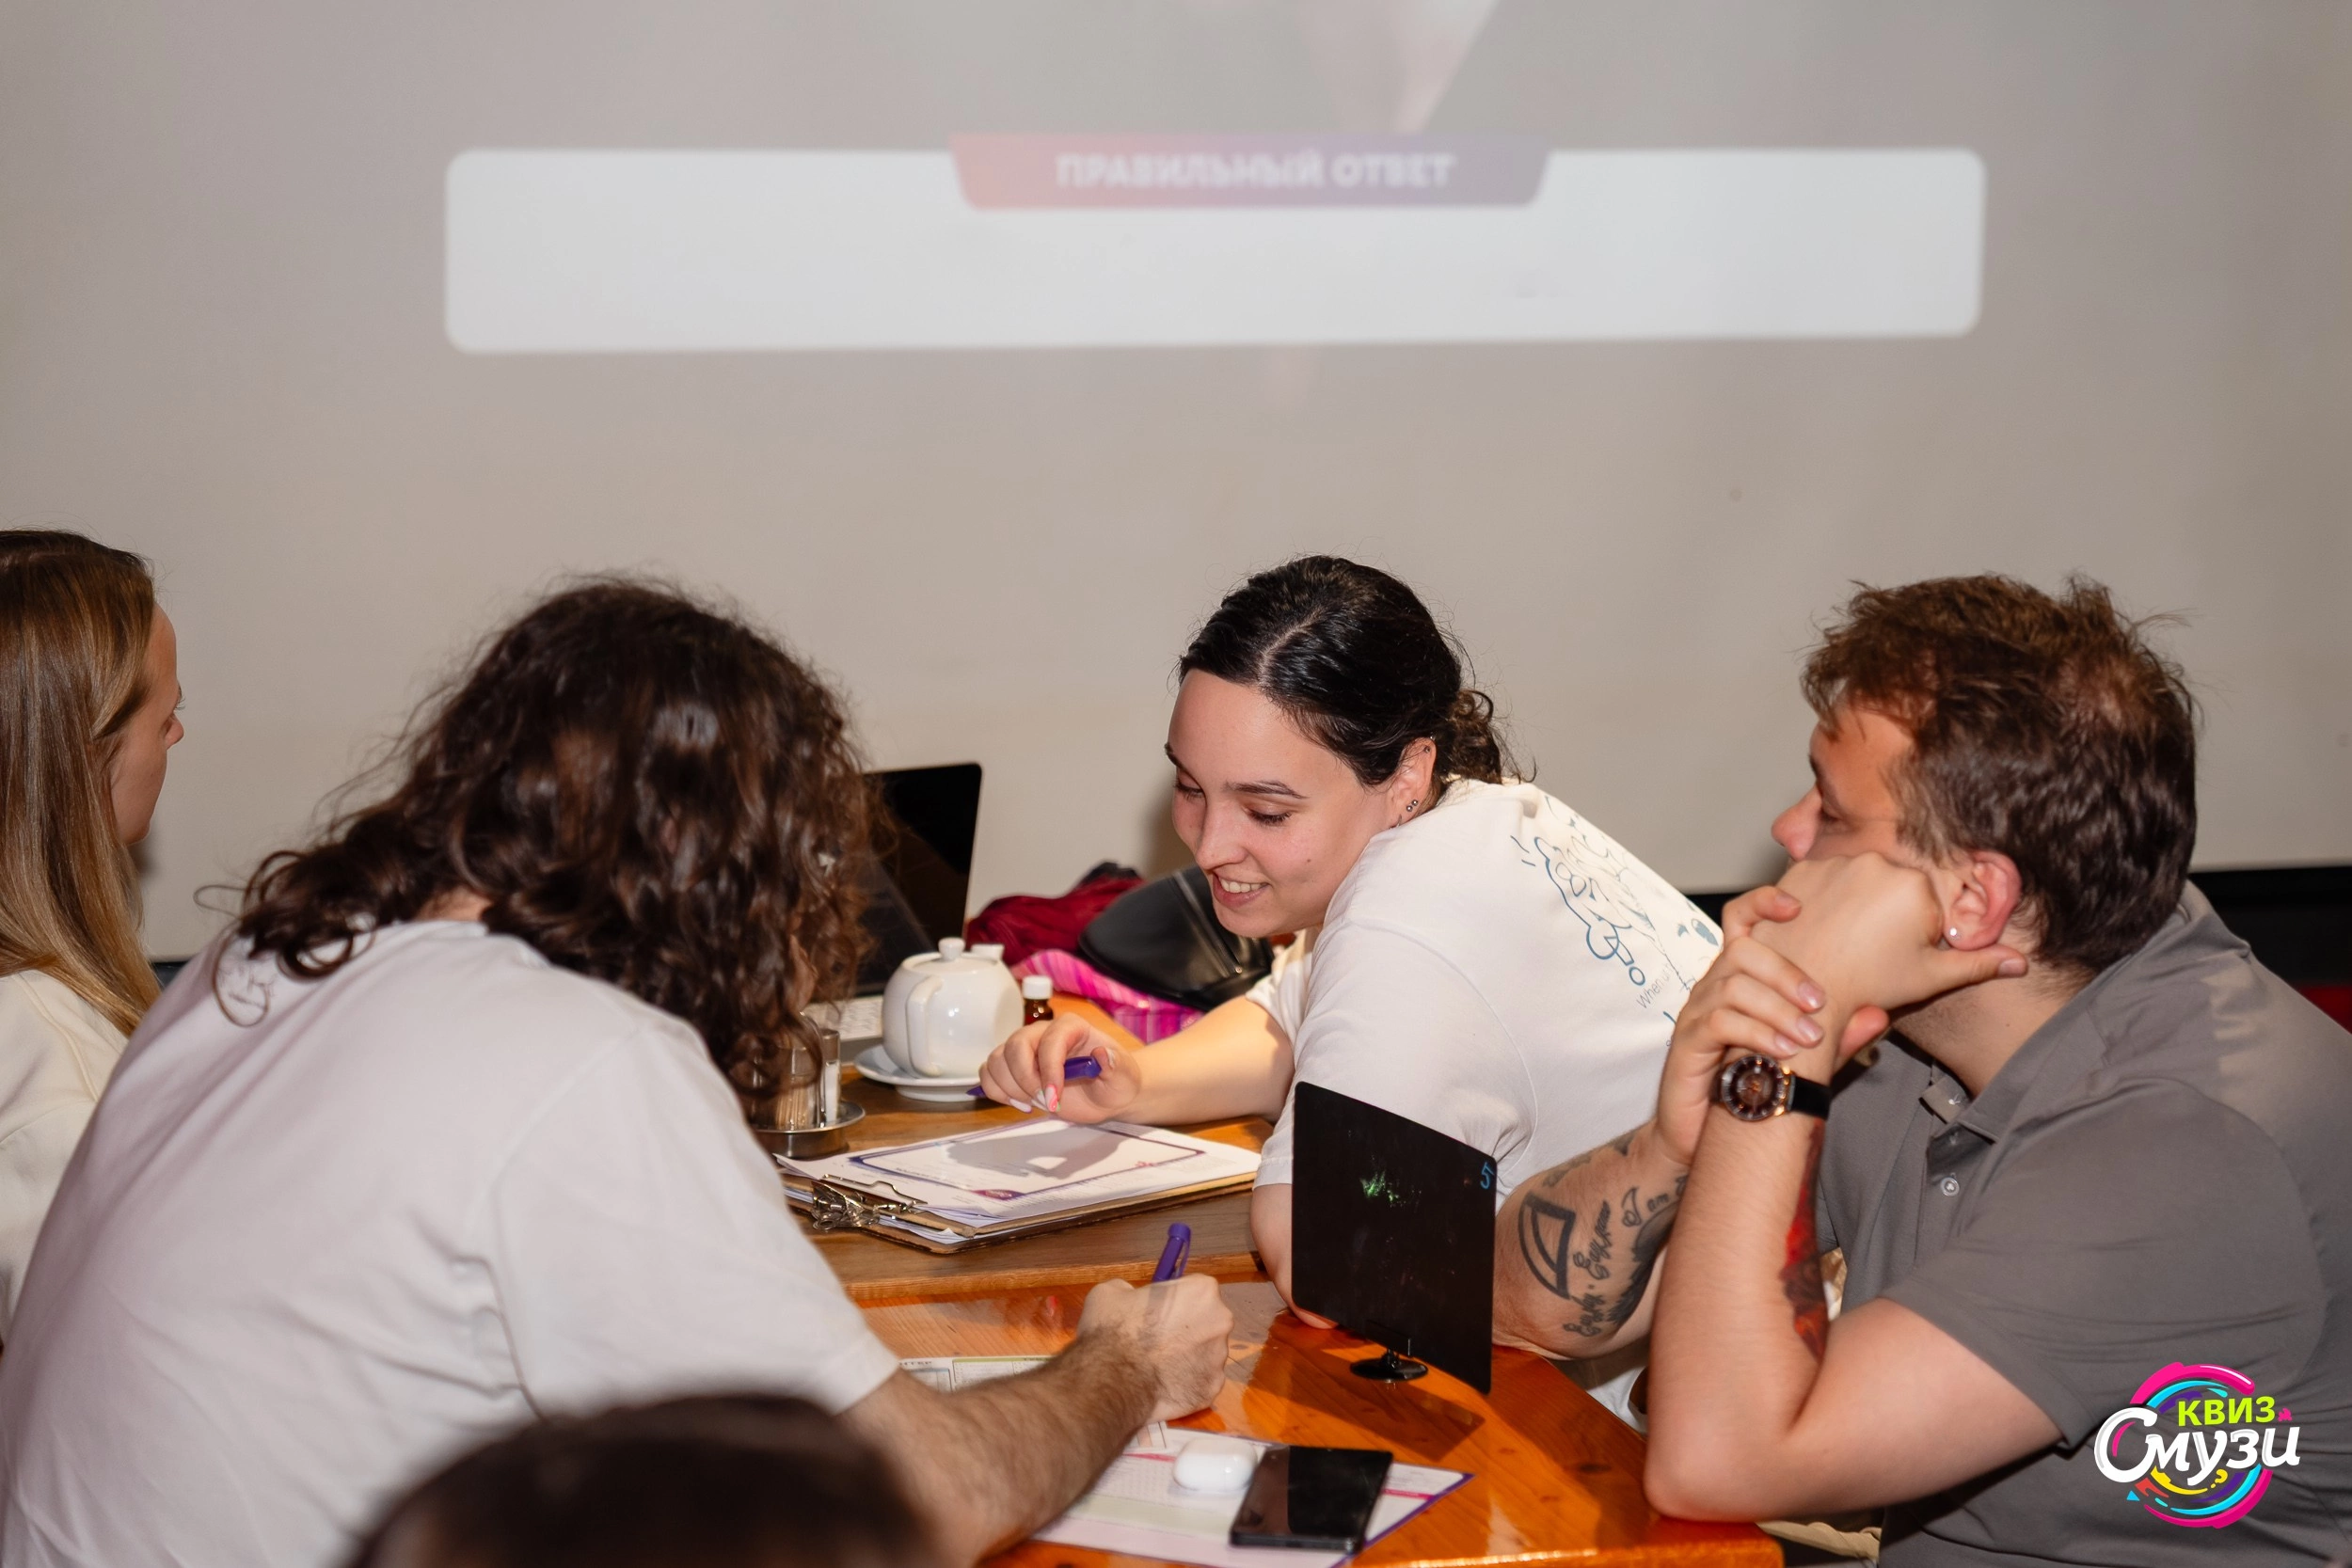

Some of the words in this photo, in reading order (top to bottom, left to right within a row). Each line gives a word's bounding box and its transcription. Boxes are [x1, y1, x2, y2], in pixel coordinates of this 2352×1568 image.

[1057, 150, 1318, 186] ПРАВИЛЬНЫЙ
[1332, 153, 1455, 186] ОТВЕТ
[1635, 977, 1665, 1008] When
[1480, 1162, 1494, 1190] 5
